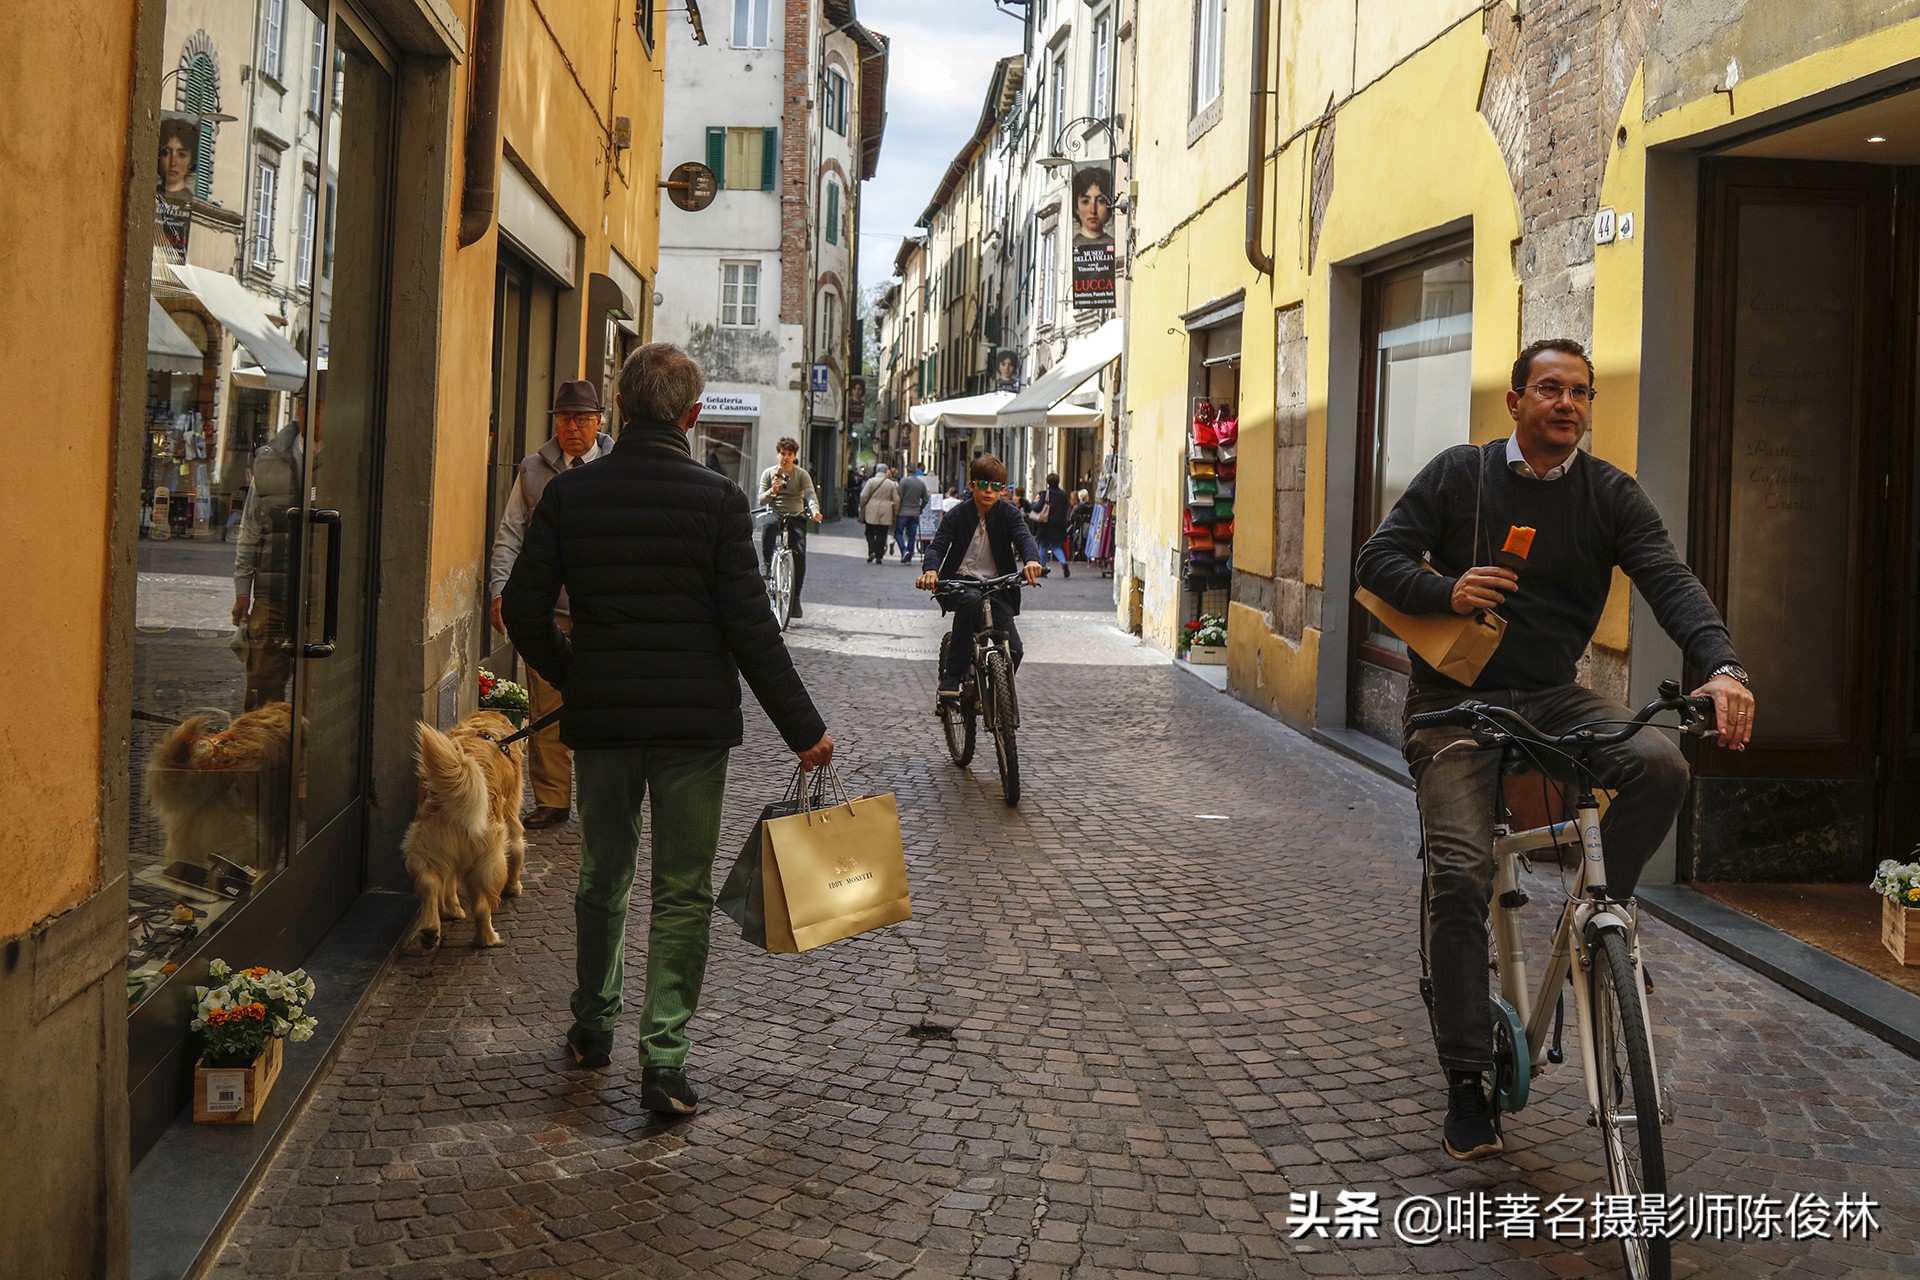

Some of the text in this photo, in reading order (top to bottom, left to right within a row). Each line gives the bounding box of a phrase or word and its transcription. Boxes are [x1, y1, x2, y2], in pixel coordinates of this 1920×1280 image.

[1598, 215, 1610, 237] 44
[1075, 279, 1113, 291] LUCCA
[813, 366, 827, 384] T
[706, 396, 743, 404] Gelateria
